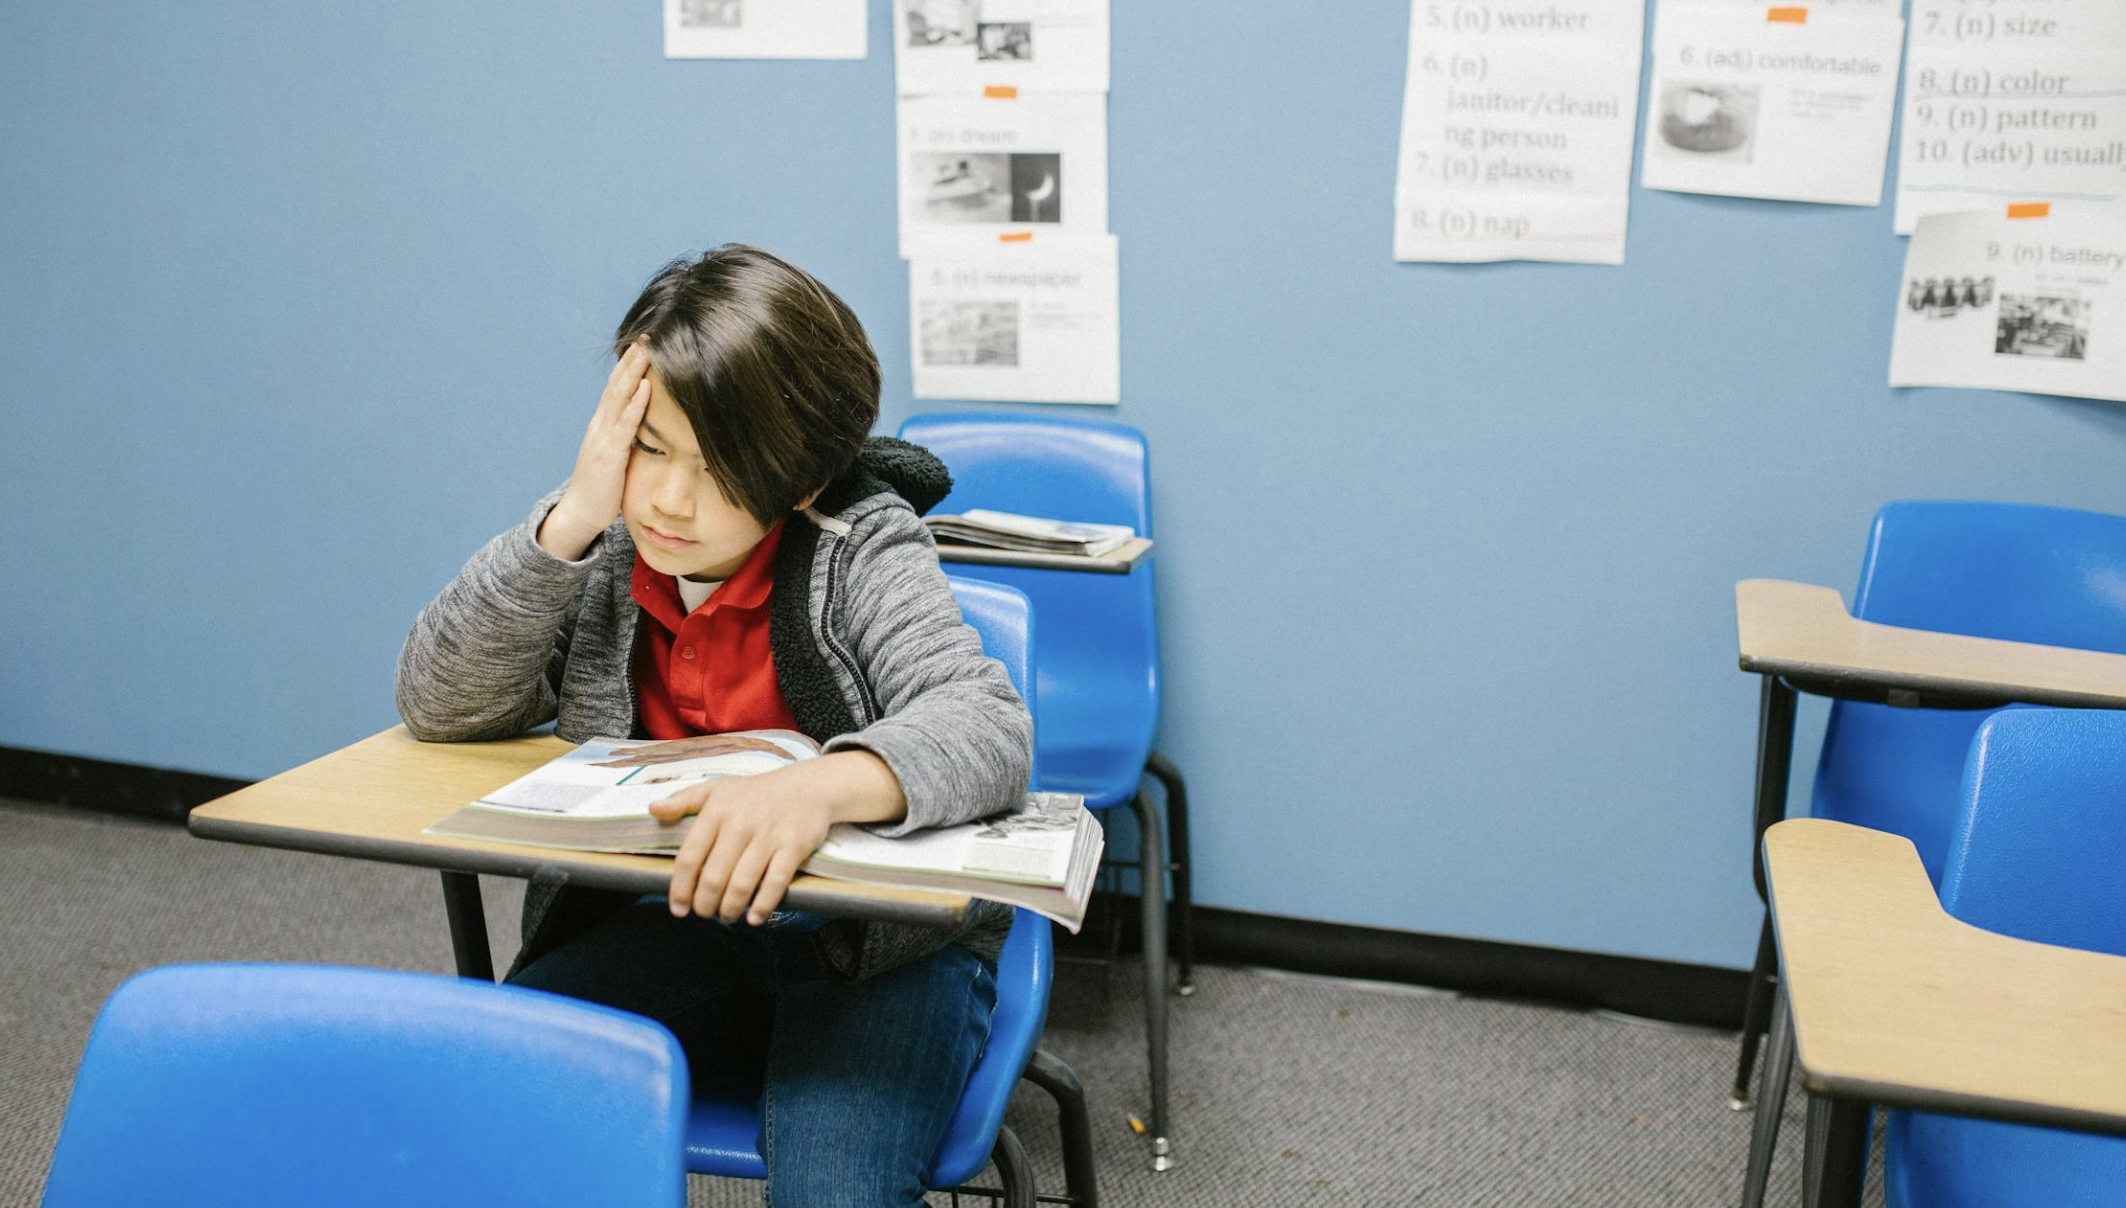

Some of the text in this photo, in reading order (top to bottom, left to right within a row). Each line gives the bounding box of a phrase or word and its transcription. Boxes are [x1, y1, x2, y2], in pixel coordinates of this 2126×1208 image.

[1453, 4, 1490, 34] (n)
[1498, 6, 1592, 31] worker
[1925, 11, 2057, 41] 7. (n) size
[1450, 53, 1488, 81] (n)
[1758, 53, 1882, 77] comfortable
[1919, 68, 2072, 97] 8. (n) color
[1446, 89, 1619, 119] janitor/cleani
[1916, 103, 2097, 133] 9. (n) pattern
[1444, 124, 1568, 151] ng person
[1442, 154, 1479, 182] (n)
[1486, 156, 1574, 185] glasses
[1917, 139, 1954, 163] 10.
[1962, 139, 2034, 171] (adv)
[1439, 210, 1476, 239] (n)
[1484, 215, 1530, 240] nap
[2013, 242, 2043, 267] (n)
[2050, 245, 2126, 272] battery
[982, 270, 1081, 290] newspaper
